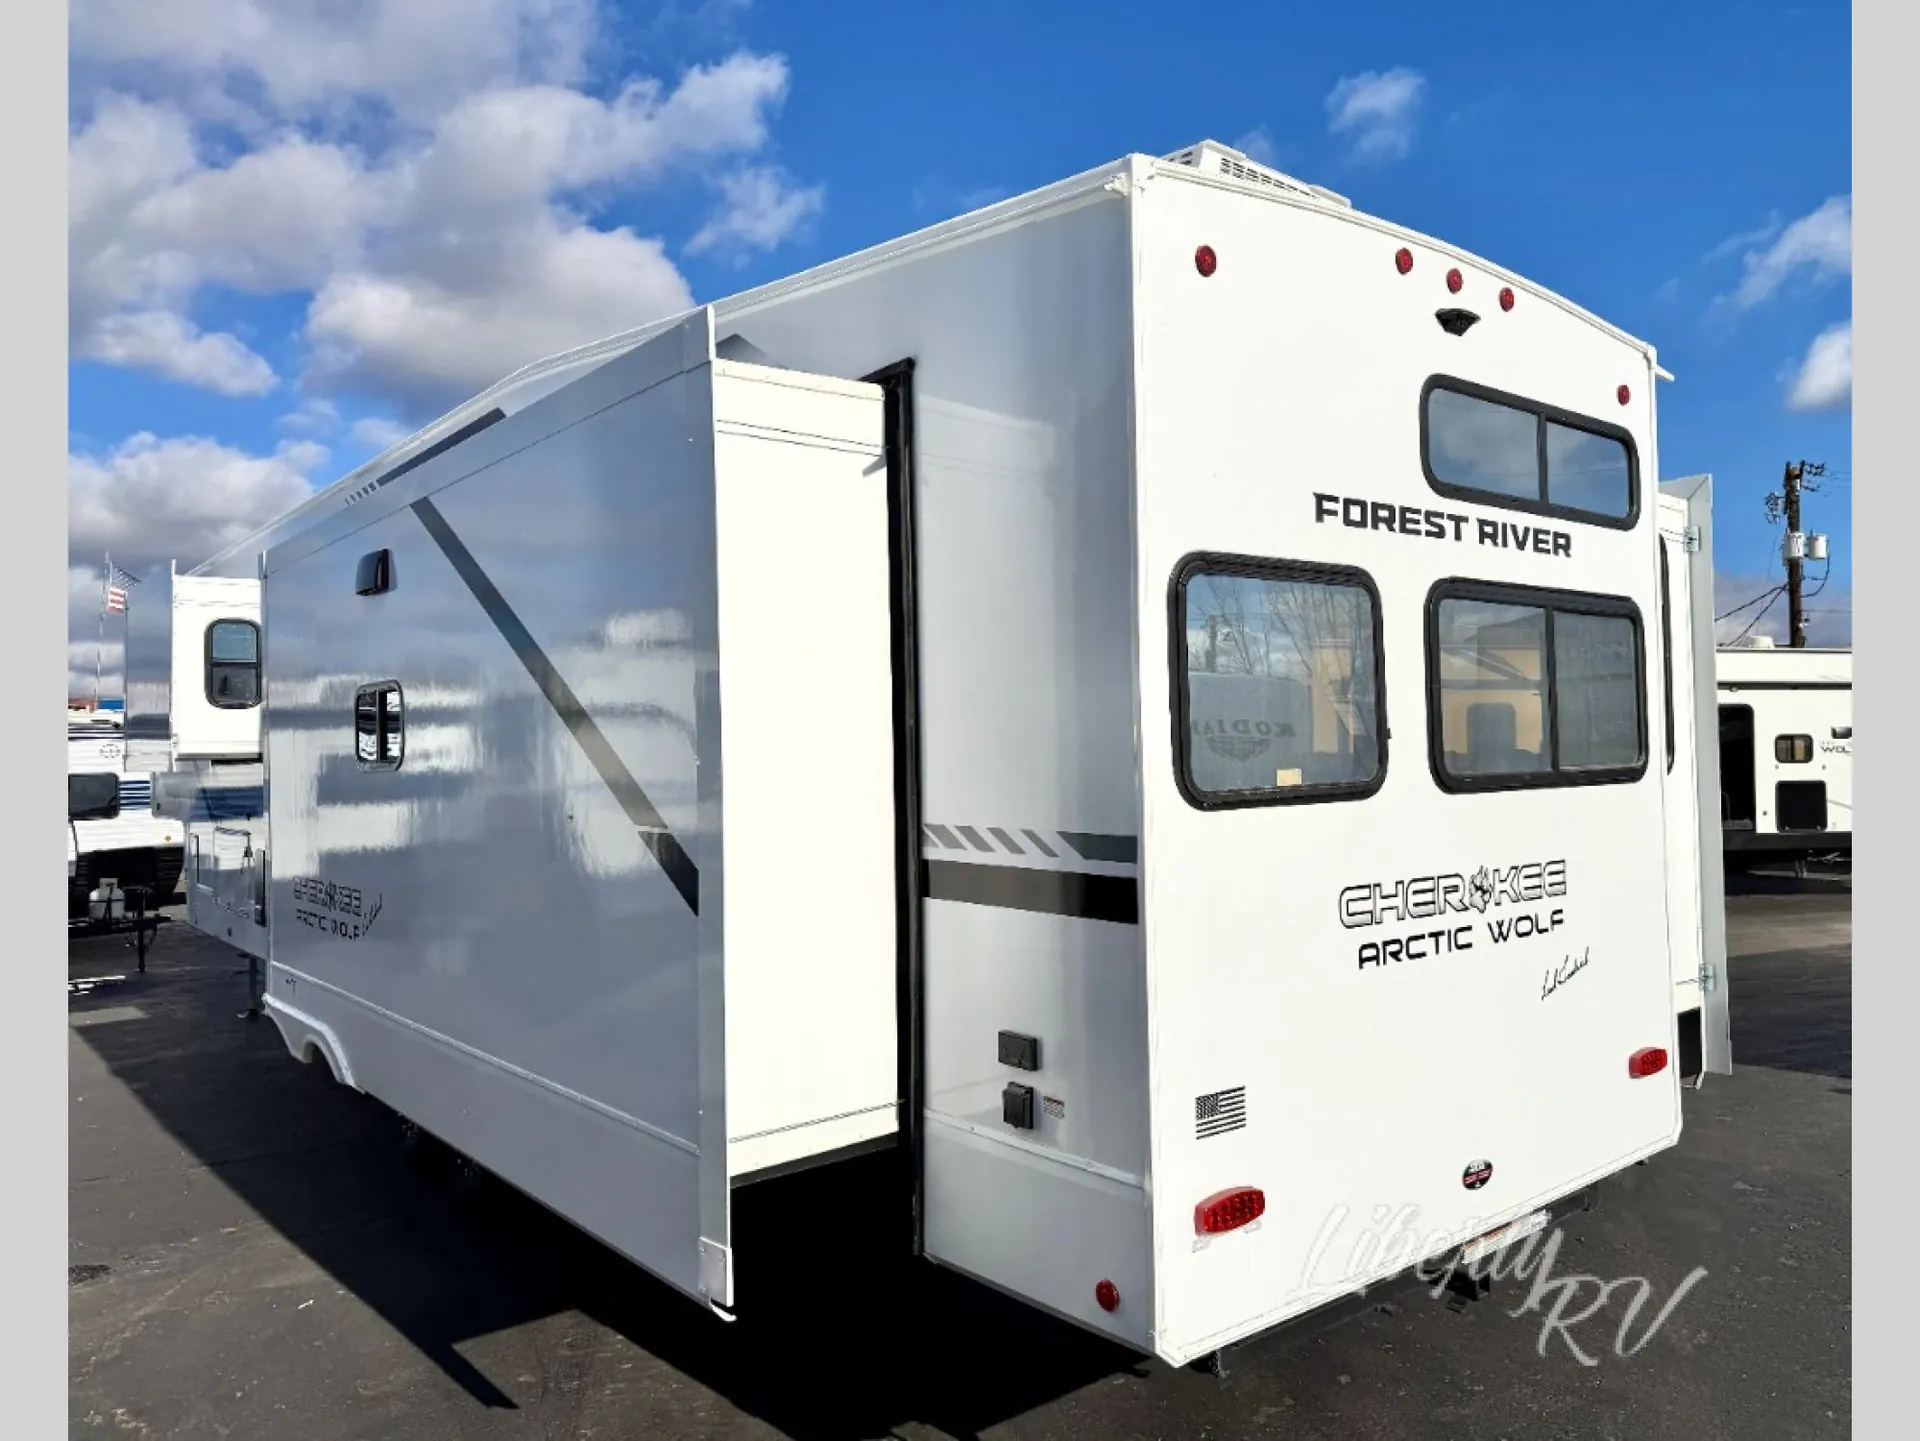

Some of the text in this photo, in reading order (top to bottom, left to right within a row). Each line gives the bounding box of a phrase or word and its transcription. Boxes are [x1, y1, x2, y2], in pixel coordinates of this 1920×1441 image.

[1312, 492, 1572, 558] FOREST RIVER
[1338, 859, 1567, 929] CHEROKEE
[1358, 908, 1564, 970] ARCTIC WOLF
